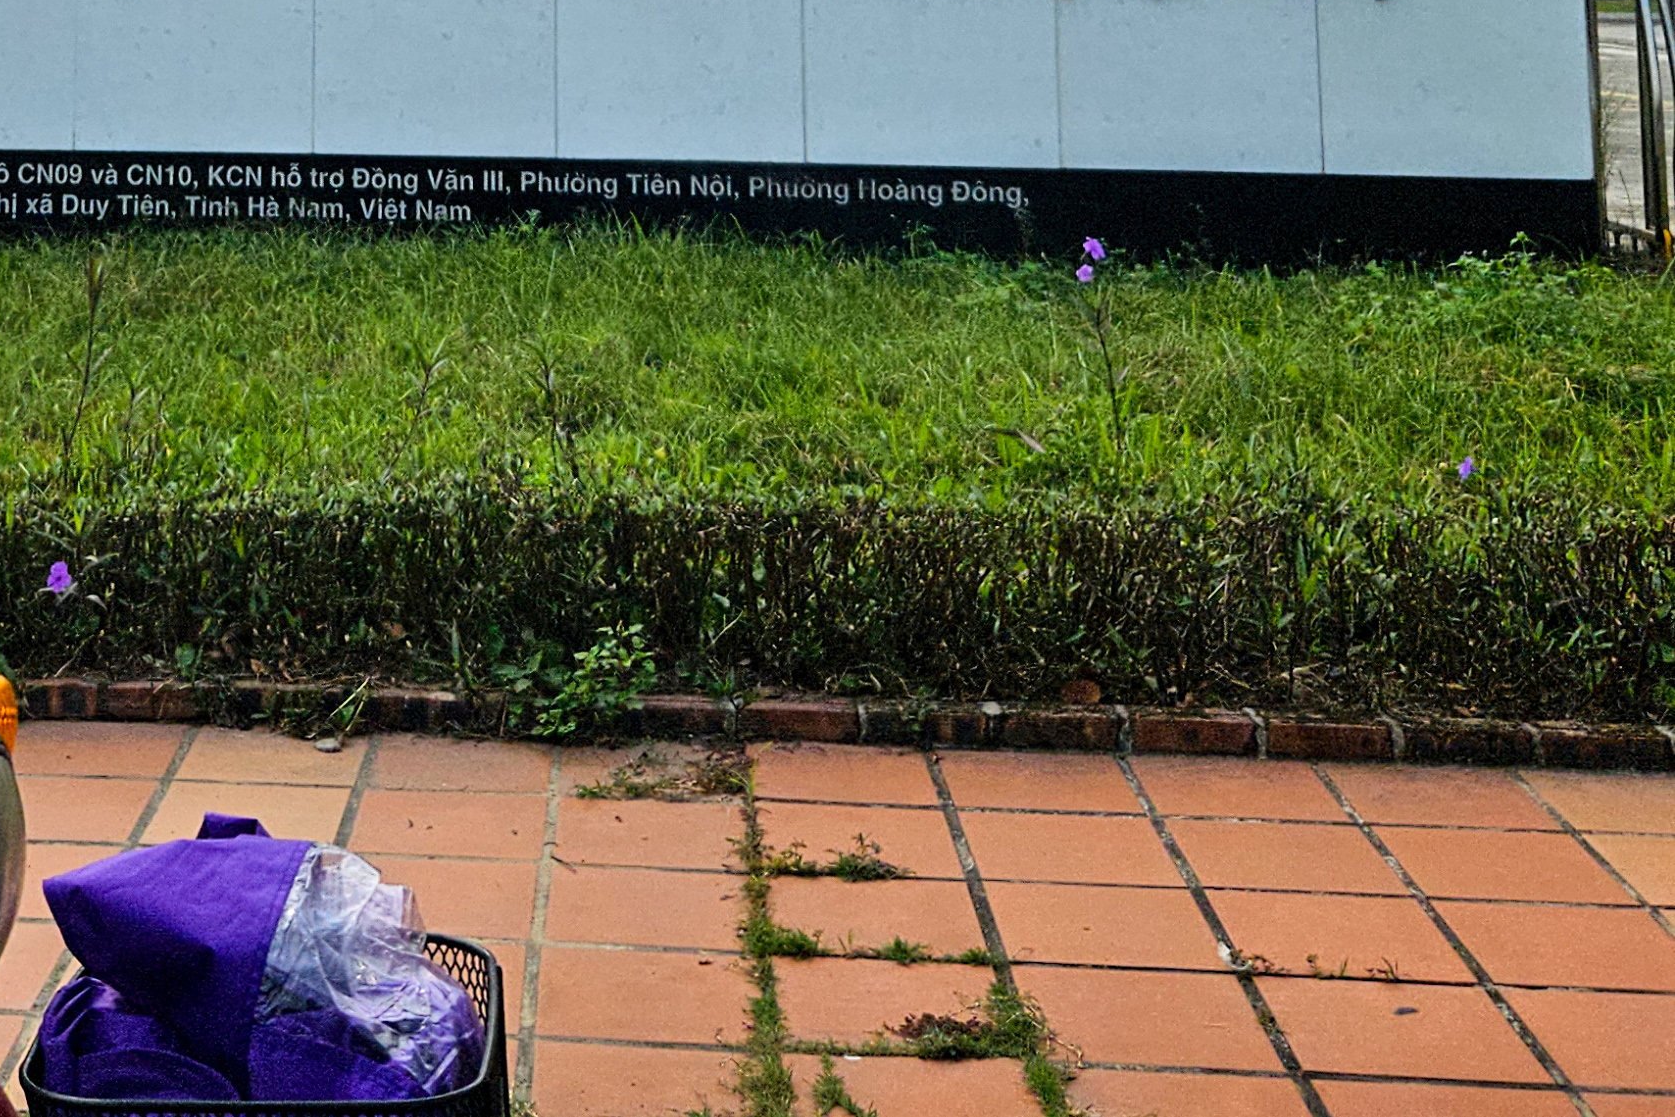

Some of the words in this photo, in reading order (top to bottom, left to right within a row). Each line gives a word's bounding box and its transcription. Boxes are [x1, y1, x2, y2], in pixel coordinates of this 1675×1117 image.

[18, 163, 83, 185] CN09
[91, 163, 119, 185] và
[127, 164, 199, 189] CN10,
[208, 165, 262, 187] KCN
[310, 167, 345, 193] trợ
[352, 166, 418, 195] Đồng
[427, 168, 474, 192] Văn
[483, 170, 511, 195] III,
[520, 170, 618, 200] Phường
[626, 173, 681, 196] Tiên
[690, 175, 740, 200] Nội,
[26, 194, 53, 214] xã
[62, 194, 109, 220] Duy
[117, 194, 176, 218] Tiên,
[248, 195, 279, 217] Hà
[289, 197, 351, 222] Nam,
[359, 198, 407, 226] Việt
[416, 199, 471, 221] Nam
